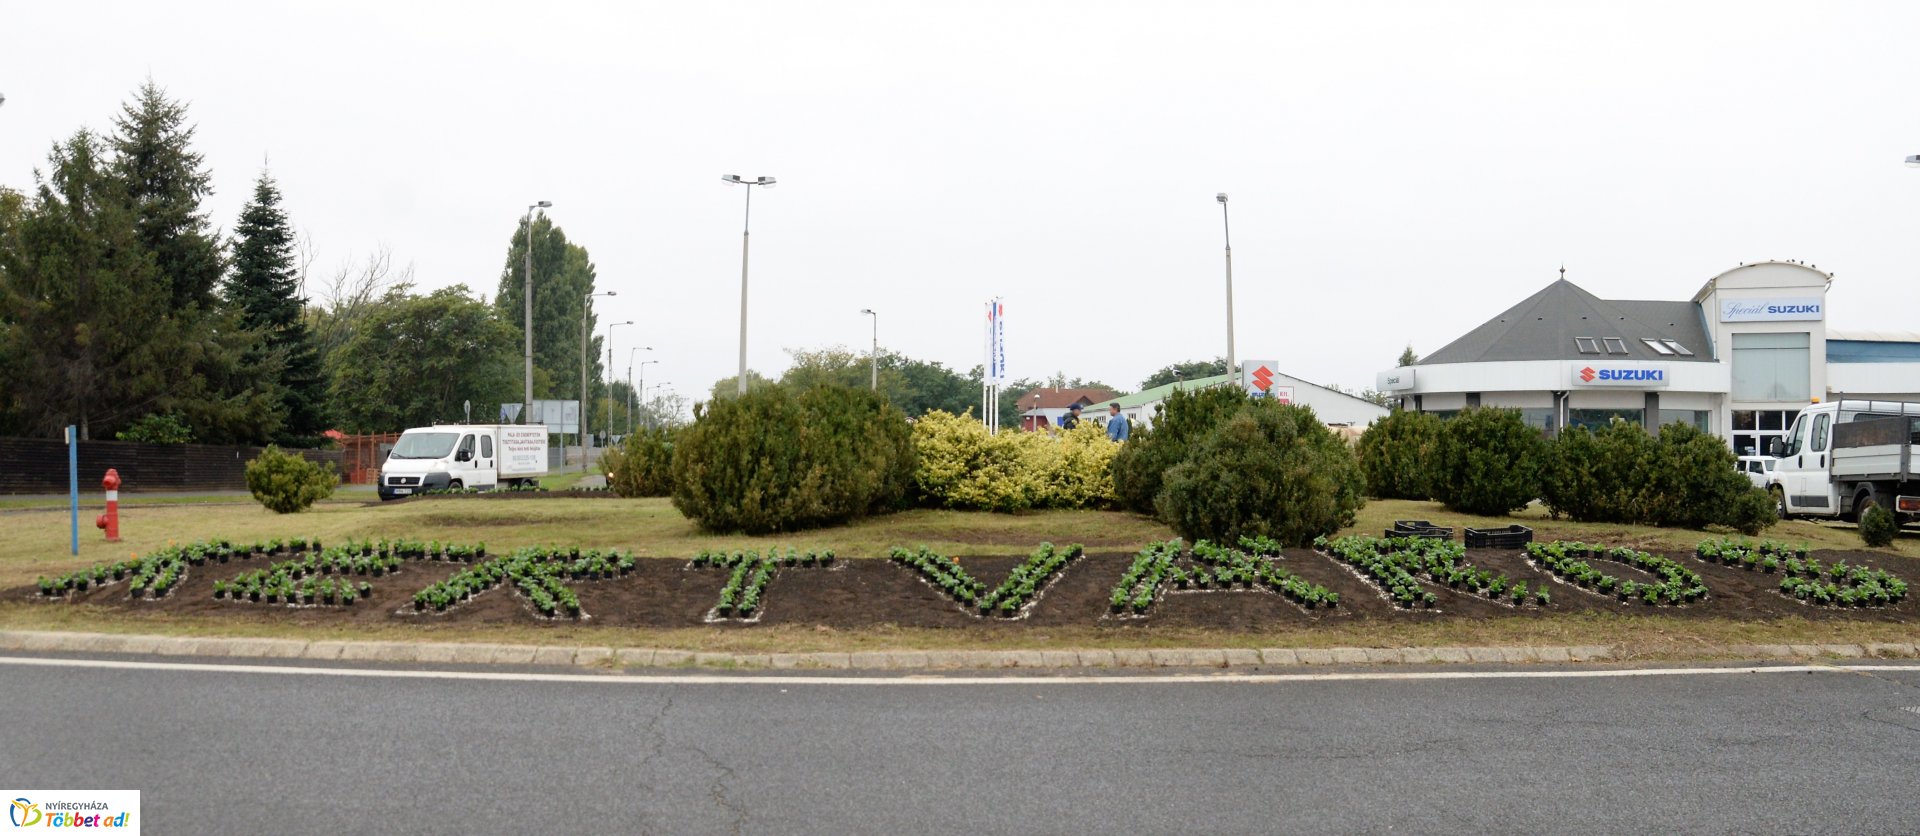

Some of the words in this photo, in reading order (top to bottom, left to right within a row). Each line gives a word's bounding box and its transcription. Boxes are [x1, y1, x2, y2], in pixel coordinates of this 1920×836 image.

[1723, 302, 1769, 319] Speciál
[1767, 305, 1820, 314] SUZUKI
[1598, 369, 1663, 381] SUZUKI
